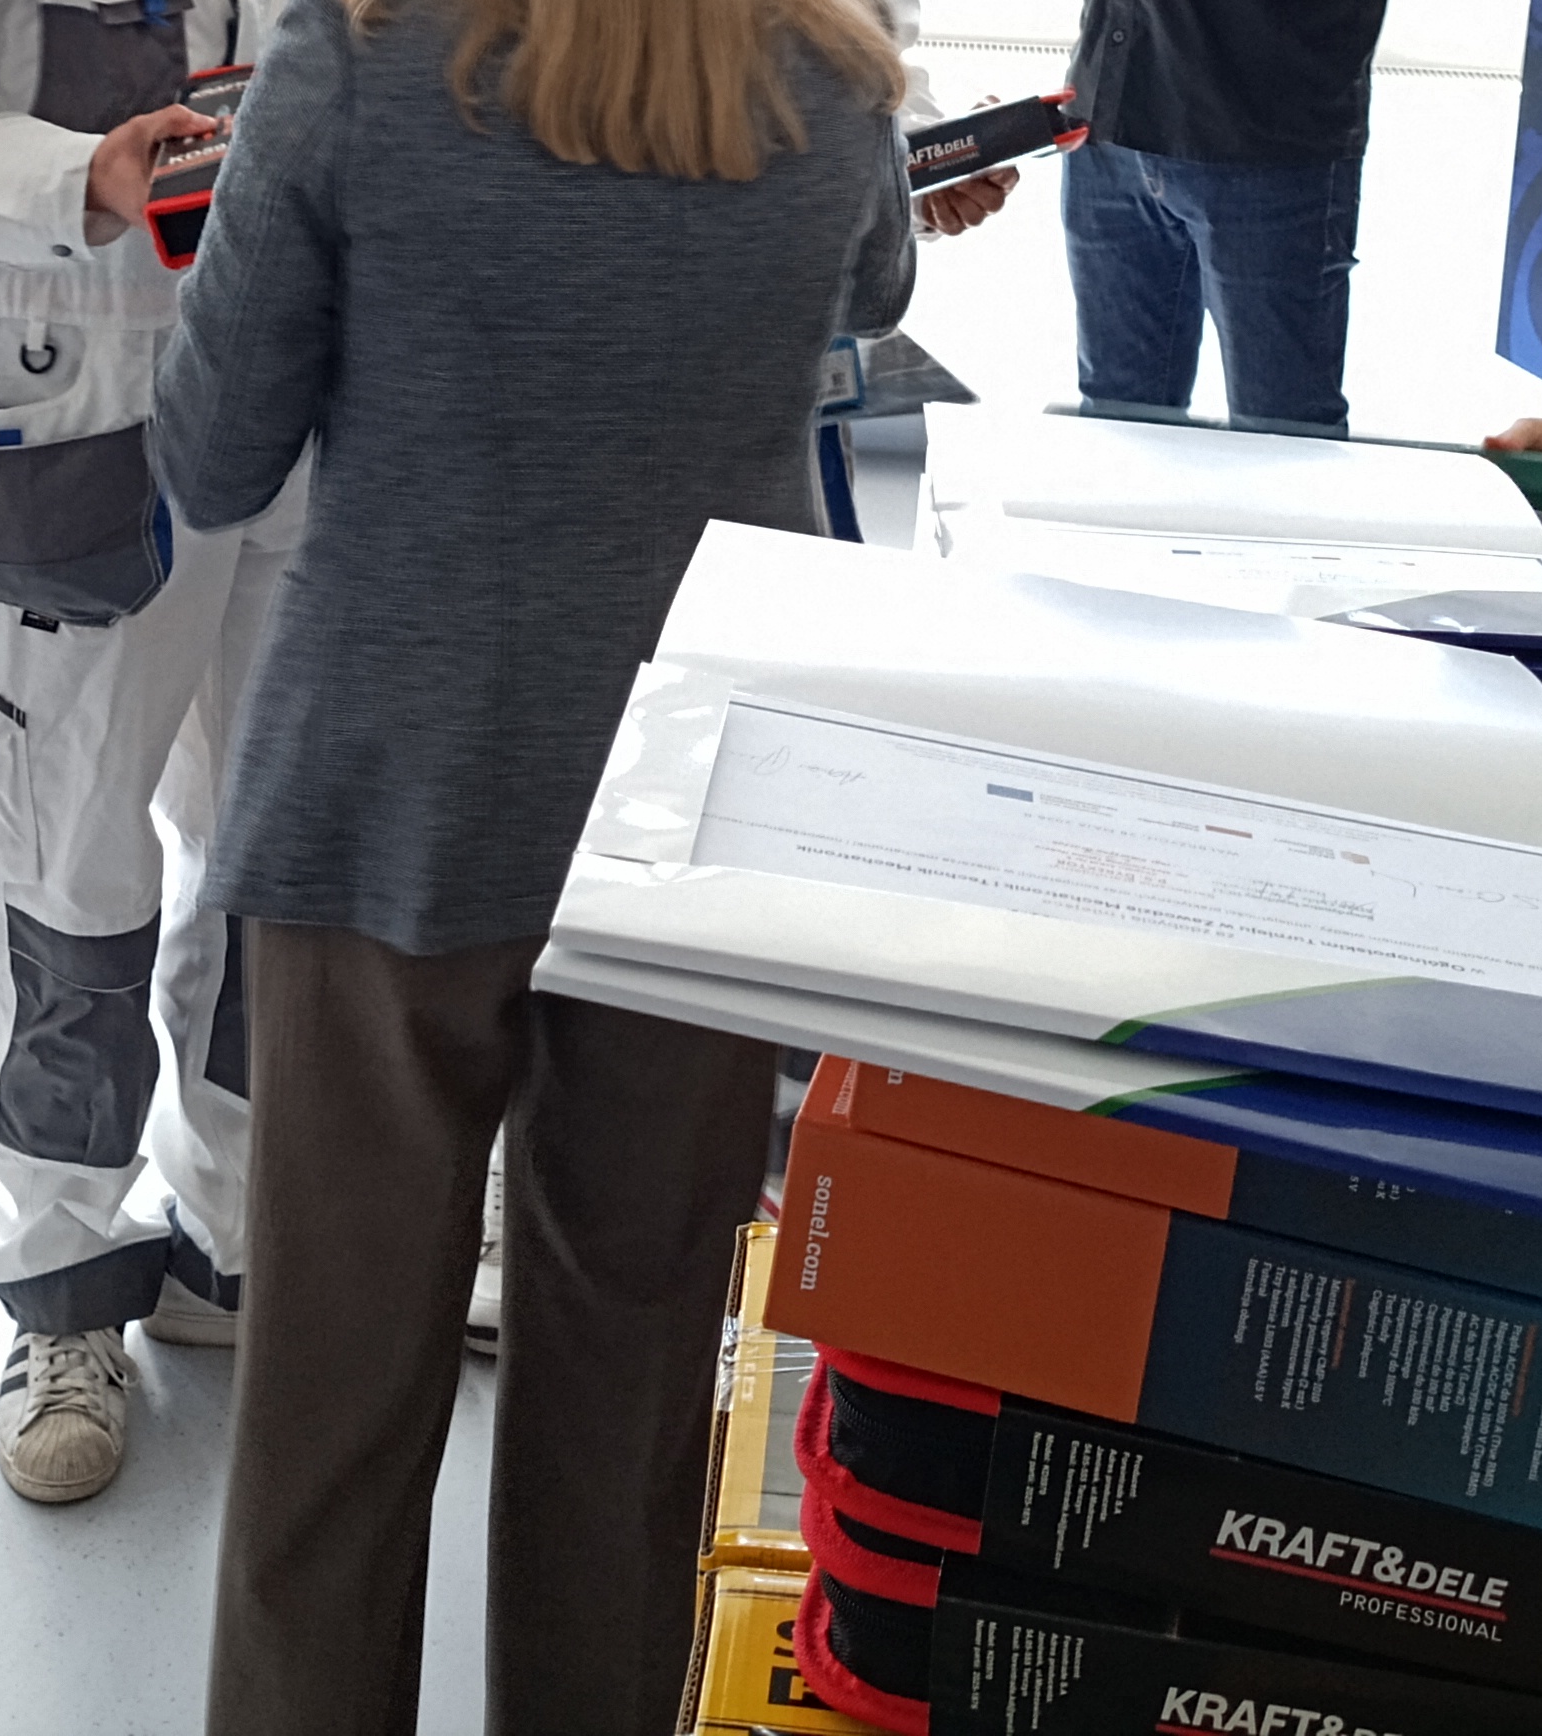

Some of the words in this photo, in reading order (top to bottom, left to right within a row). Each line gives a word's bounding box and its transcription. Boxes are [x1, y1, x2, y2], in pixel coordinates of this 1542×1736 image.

[907, 134, 976, 165] AFT&DELE
[800, 1174, 832, 1292] sonel.com
[1300, 1272, 1313, 1302] Sonda
[1326, 1278, 1341, 1317] Miernik
[1384, 1294, 1396, 1314] Test
[1377, 1315, 1392, 1342] diody
[1389, 1298, 1410, 1358] Temperatury
[1469, 1313, 1480, 1329] AC
[1287, 1304, 1306, 1375] temperaturowa
[1467, 1330, 1477, 1342] do
[1388, 1359, 1398, 1372] do
[1463, 1344, 1474, 1362] 300
[1311, 1356, 1326, 1402] CMP-1010
[1462, 1364, 1471, 1372] V
[1502, 1354, 1516, 1387] AC/DC
[1282, 1378, 1293, 1399] typu
[1500, 1387, 1510, 1400] do
[1280, 1400, 1290, 1408] K
[1495, 1402, 1507, 1423] 1000
[1494, 1424, 1503, 1432] A
[1488, 1434, 1501, 1460] (True
[1482, 1461, 1496, 1486] RMS)
[1216, 1509, 1509, 1609] KRAFT&DELE
[1340, 1591, 1504, 1642] PROFESSIONAL
